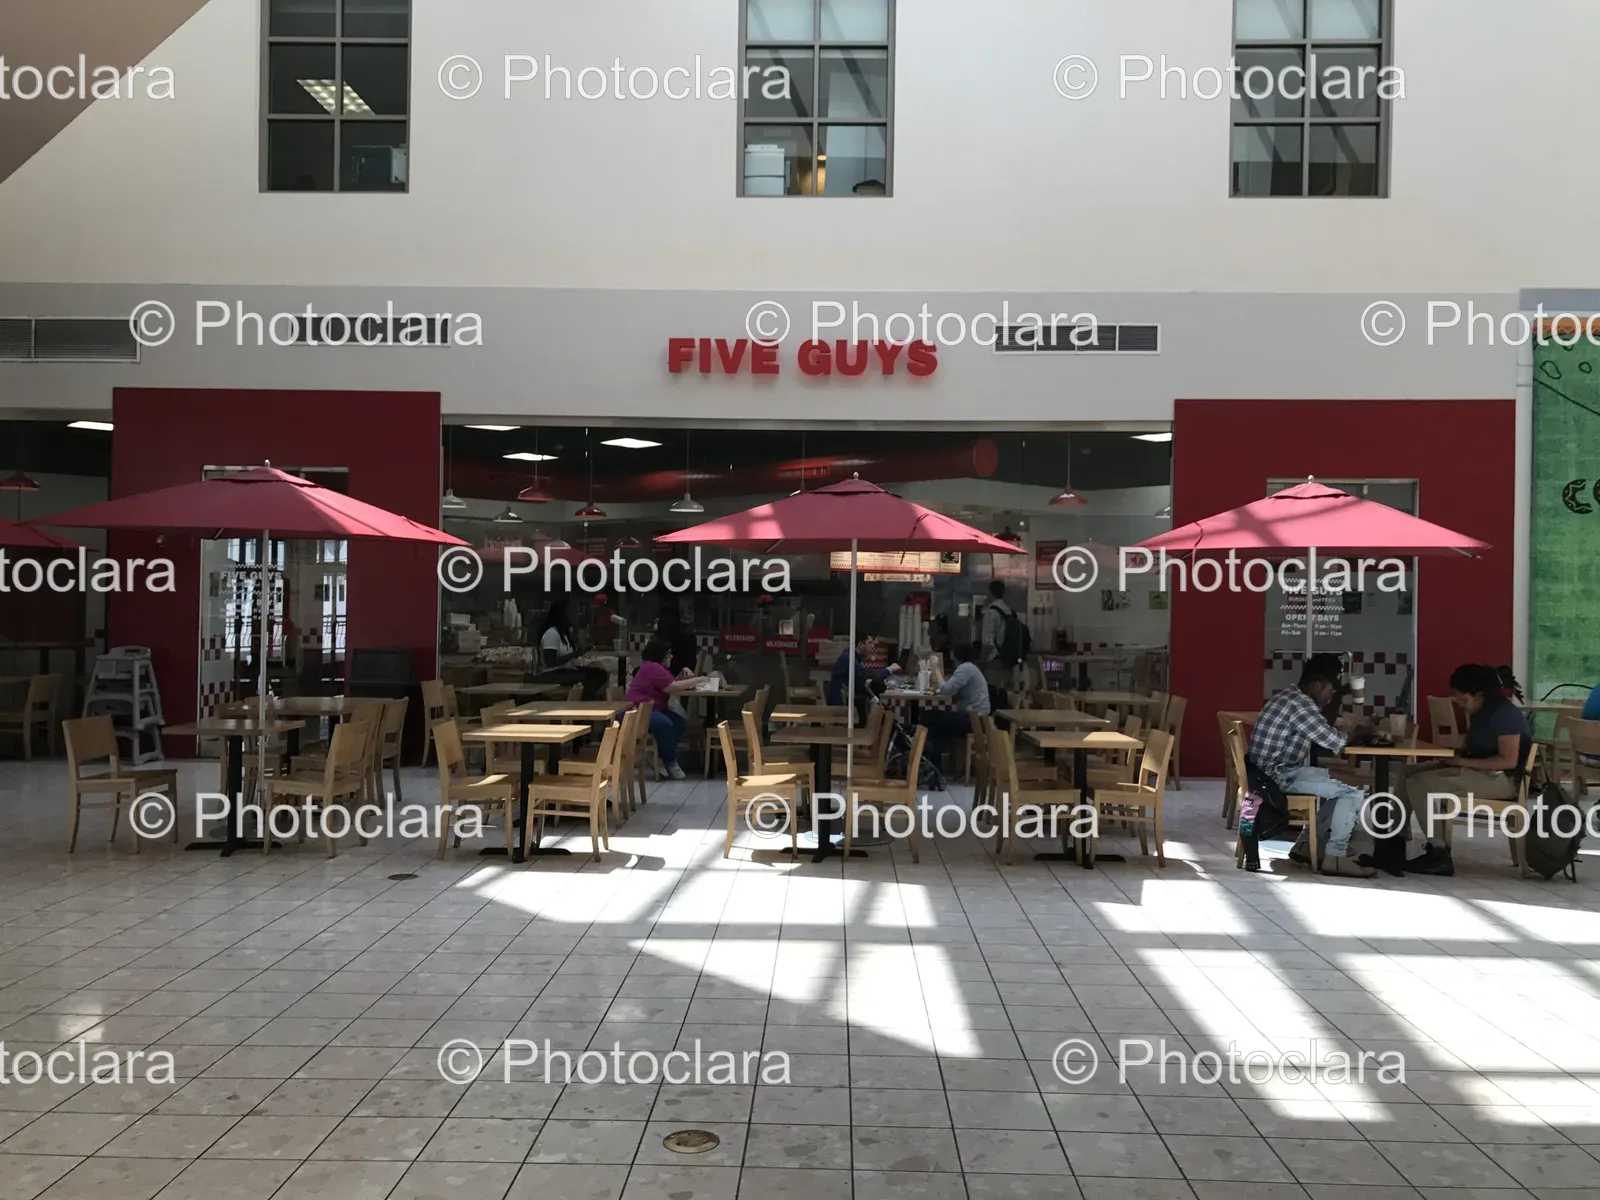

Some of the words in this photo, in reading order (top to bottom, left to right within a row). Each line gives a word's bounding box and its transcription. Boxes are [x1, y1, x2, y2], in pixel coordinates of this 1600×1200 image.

[668, 337, 780, 375] FIVE
[797, 338, 939, 377] GUYS
[1562, 478, 1600, 514] C
[220, 571, 247, 580] FIVE
